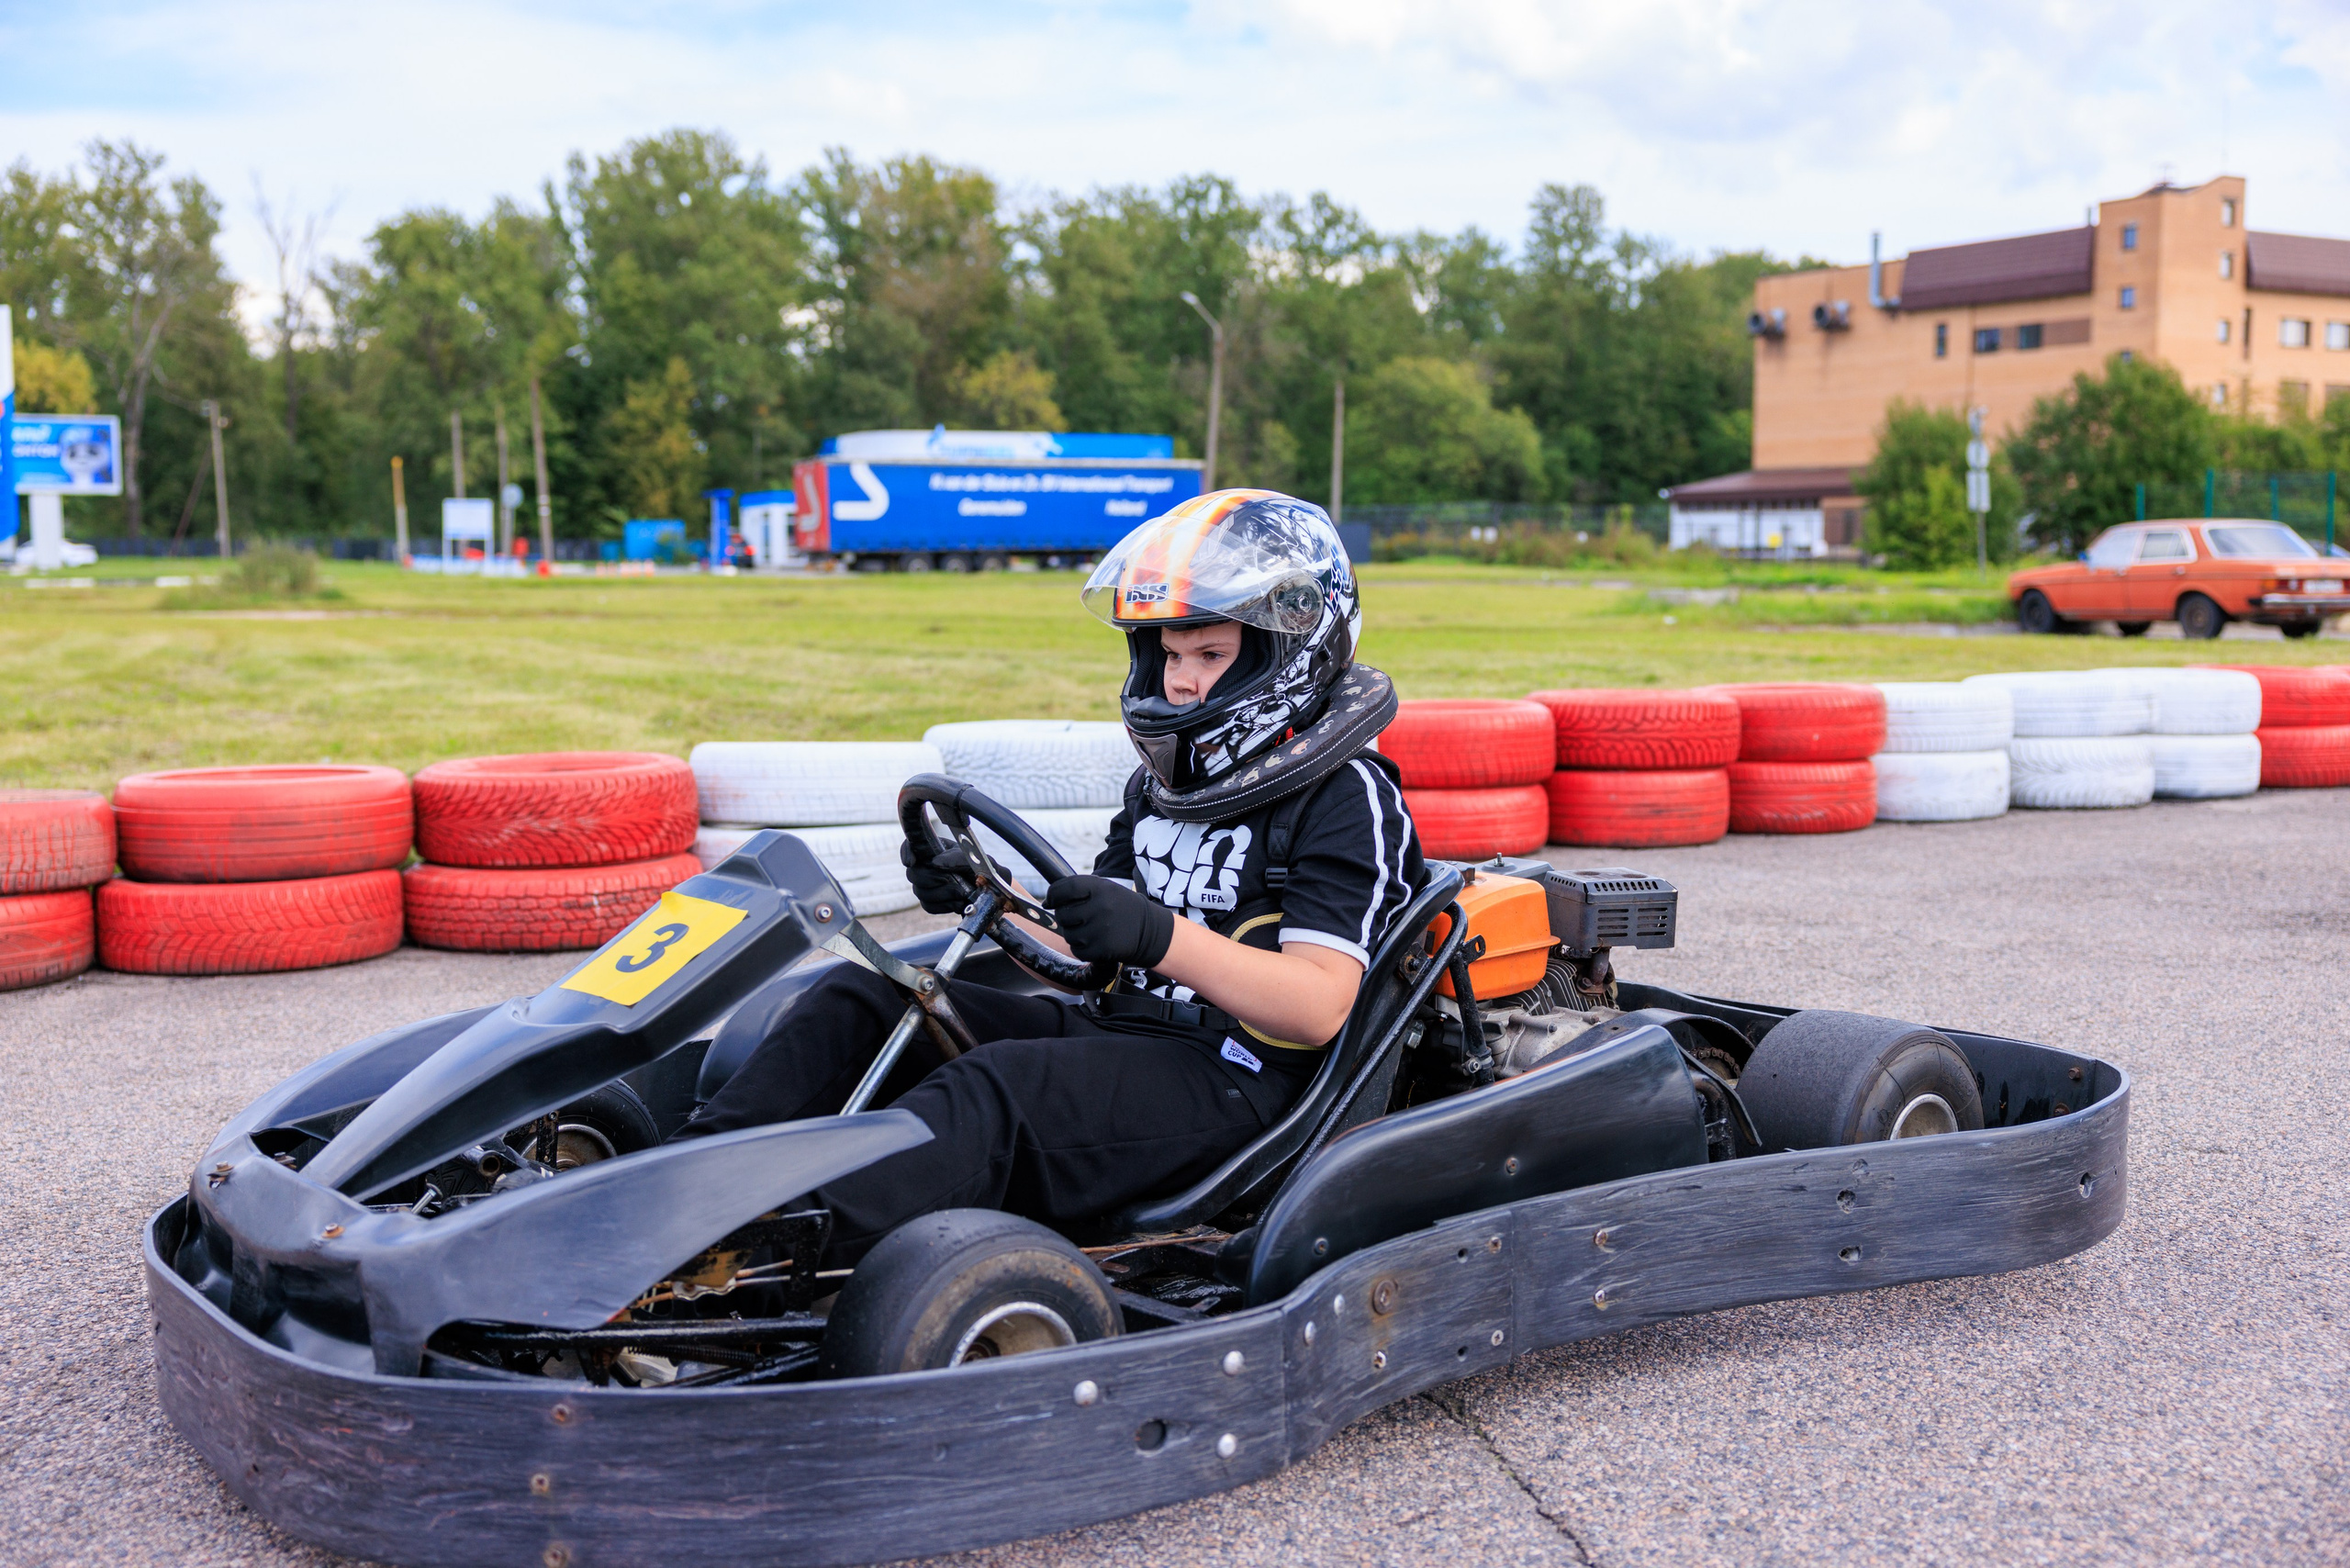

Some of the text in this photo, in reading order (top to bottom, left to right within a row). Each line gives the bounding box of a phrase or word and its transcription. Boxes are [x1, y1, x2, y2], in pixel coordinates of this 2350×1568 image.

[1201, 893, 1225, 903] FIFA
[616, 923, 689, 973] 3
[1227, 1050, 1242, 1058] CUP
